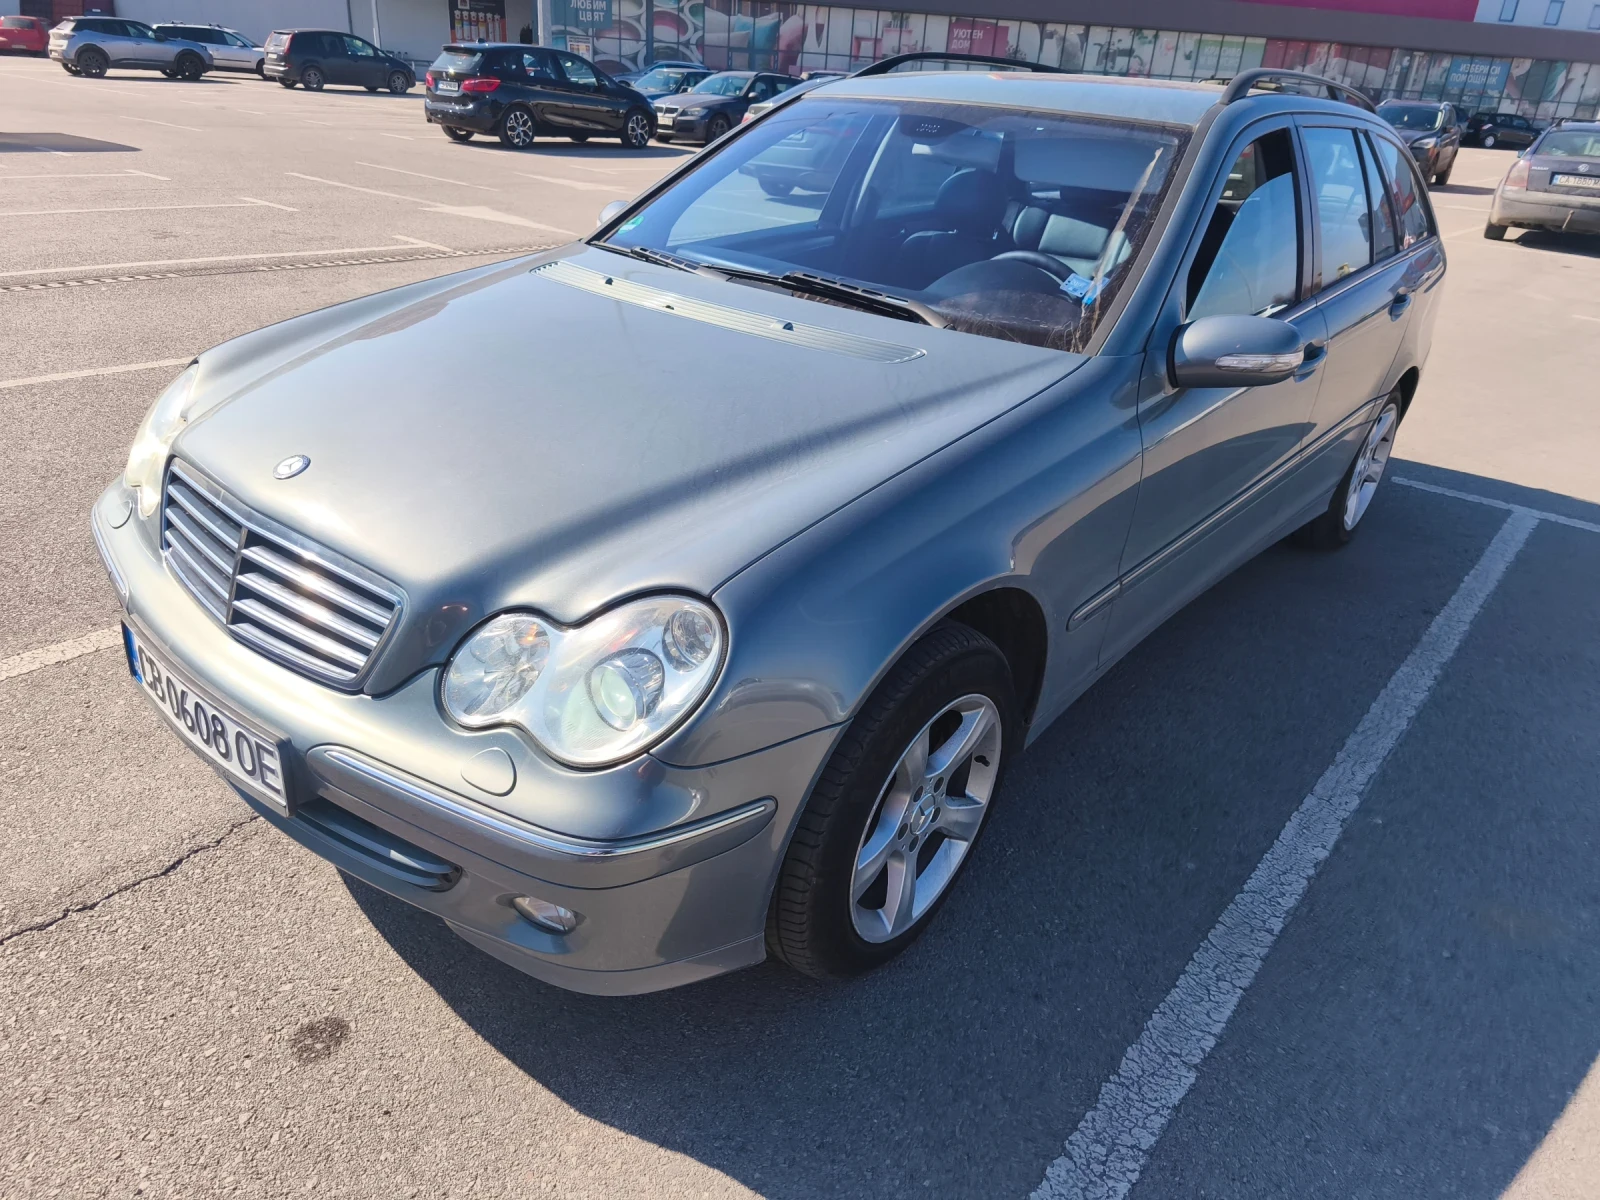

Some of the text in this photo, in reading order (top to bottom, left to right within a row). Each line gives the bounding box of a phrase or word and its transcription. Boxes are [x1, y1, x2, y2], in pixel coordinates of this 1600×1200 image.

[570, 0, 607, 10] ЛЮБИМ
[579, 10, 605, 23] ЦВЯТ
[953, 28, 984, 39] УЮТЕН
[951, 39, 971, 50] ДОМ
[1460, 63, 1490, 74] ИЗБЕРИ
[138, 644, 167, 705] CB
[166, 675, 232, 764] 0608
[235, 730, 282, 795] OE
